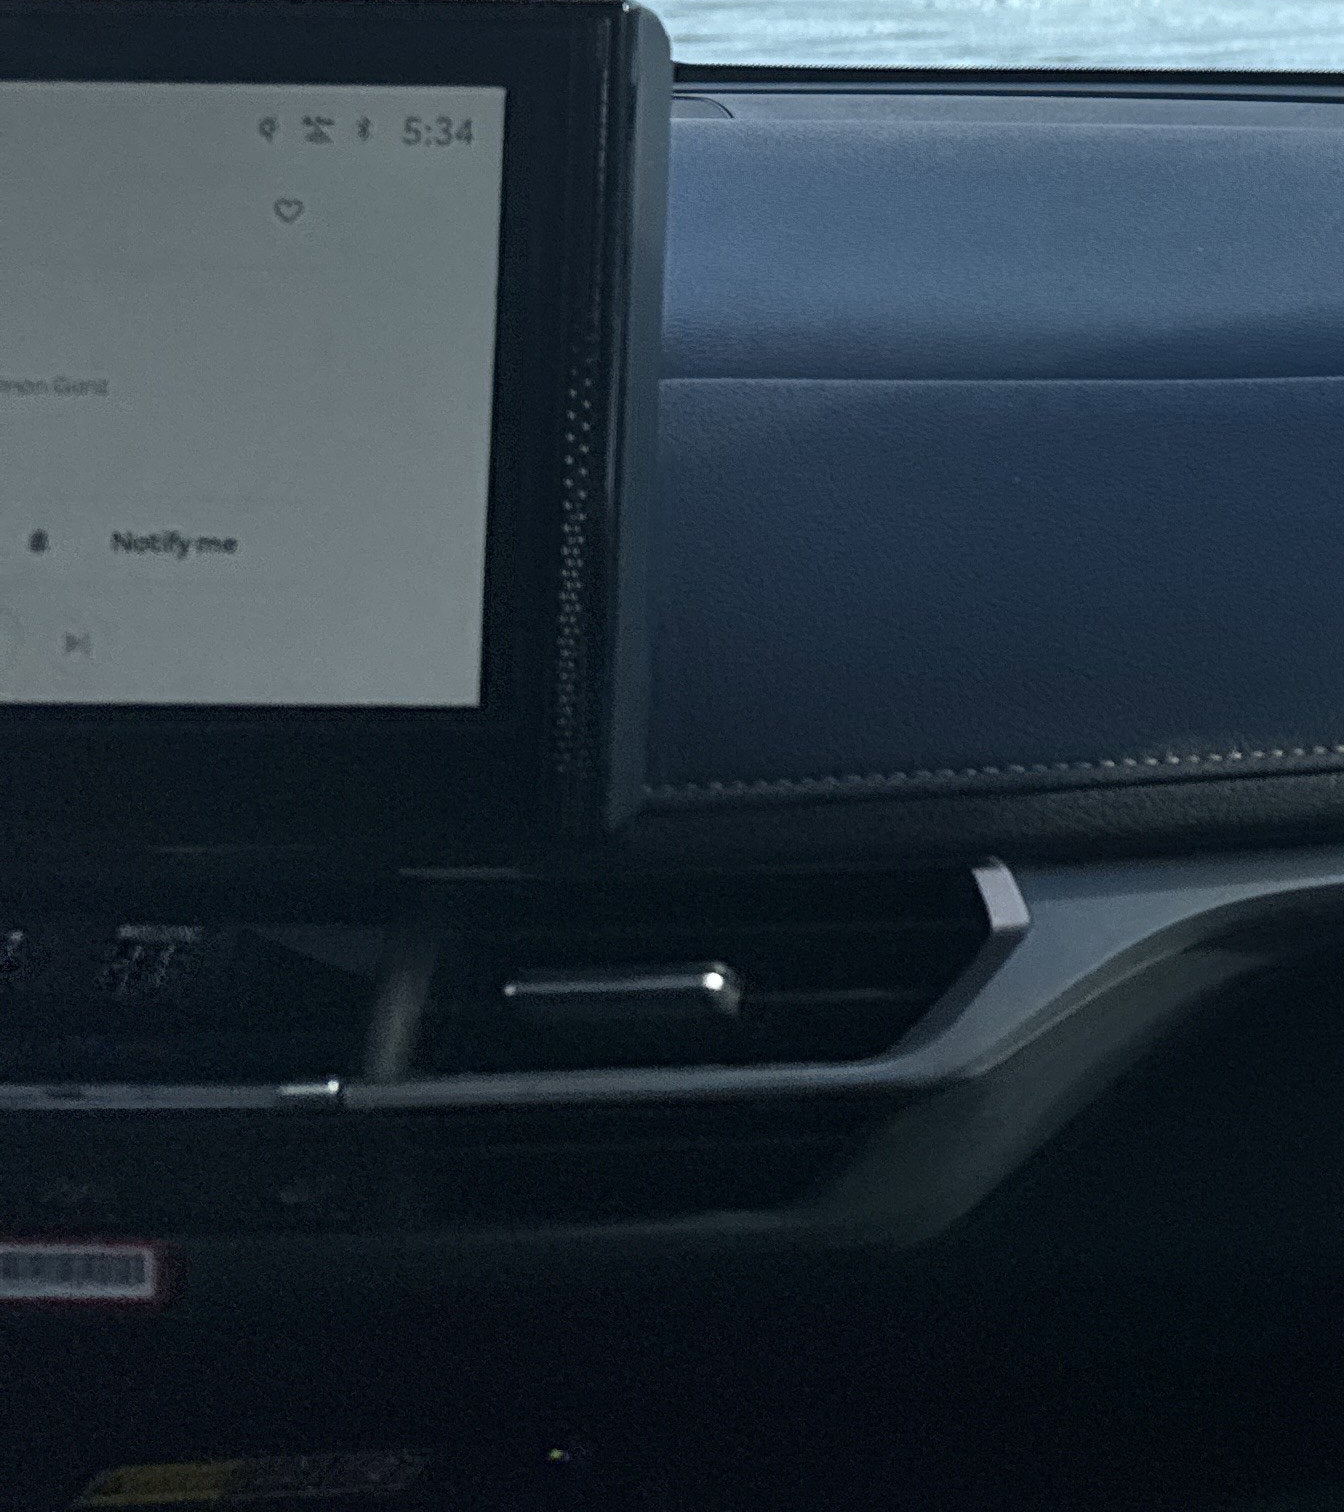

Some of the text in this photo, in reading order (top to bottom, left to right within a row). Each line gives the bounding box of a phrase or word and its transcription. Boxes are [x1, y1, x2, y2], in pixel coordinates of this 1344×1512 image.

[402, 115, 473, 146] 5:34
[111, 530, 239, 560] Notify me
